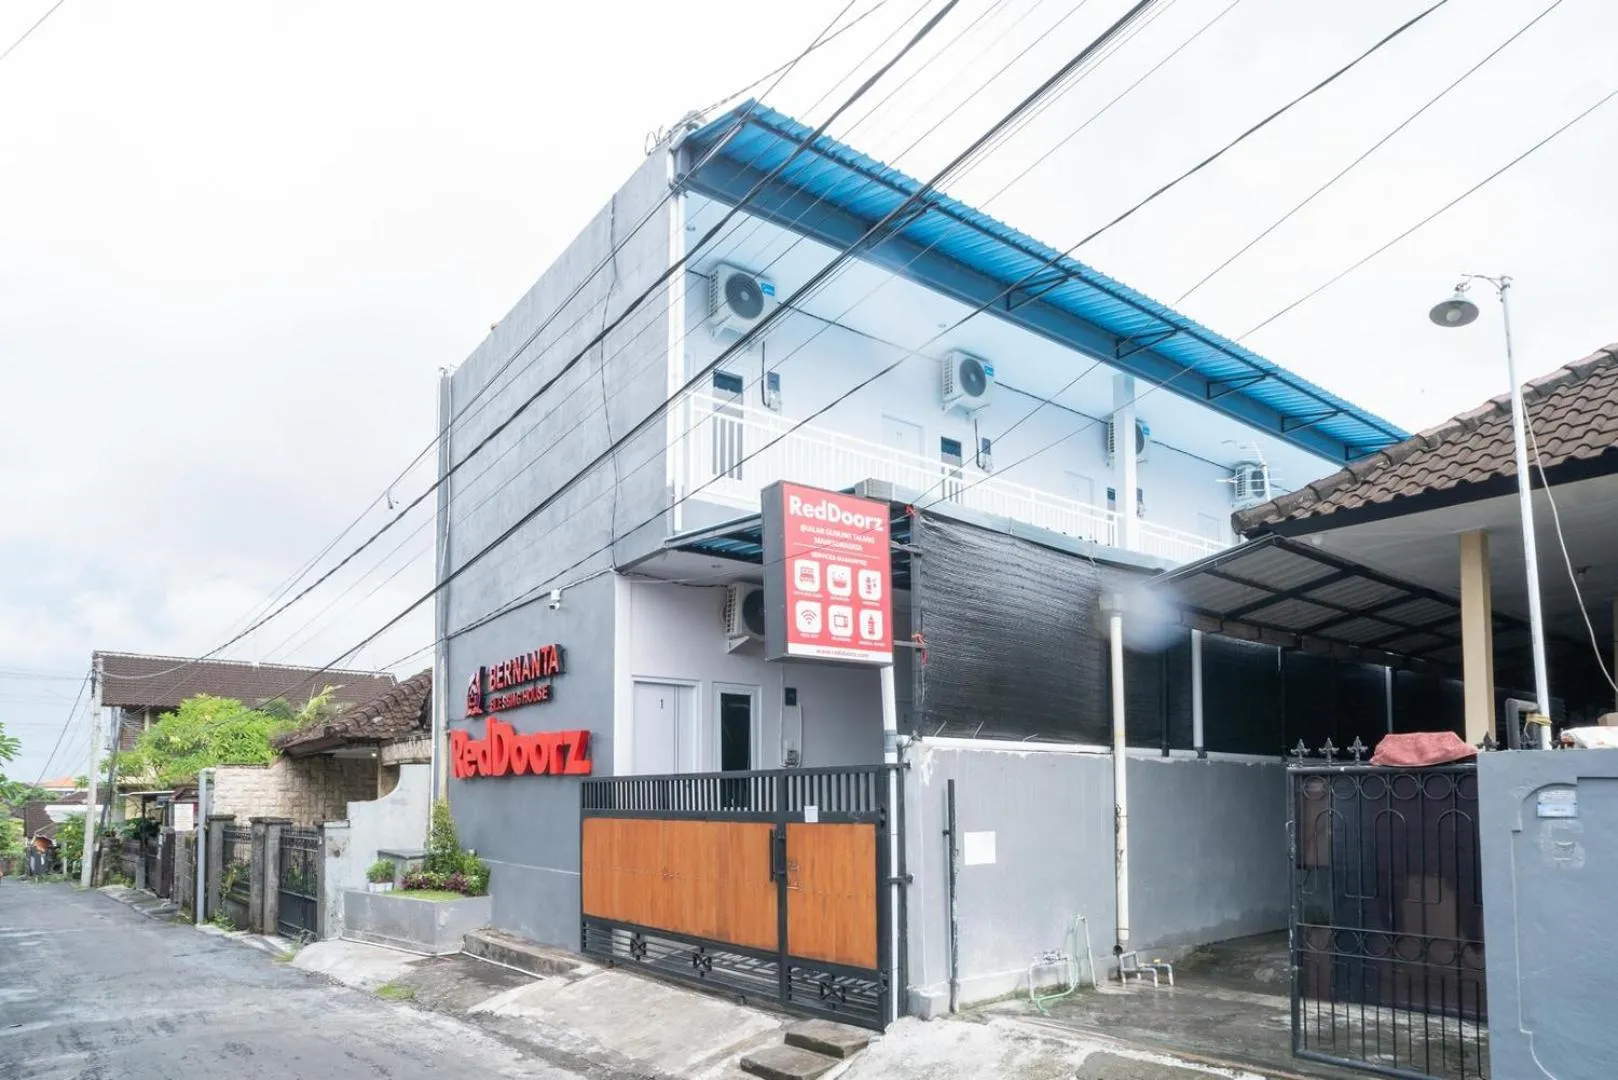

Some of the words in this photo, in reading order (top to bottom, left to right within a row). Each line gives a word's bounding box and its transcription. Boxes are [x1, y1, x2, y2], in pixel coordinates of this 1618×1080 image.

[788, 494, 884, 532] RedDoorz
[488, 643, 561, 692] BERNANTA
[450, 716, 593, 779] RedDoorz
